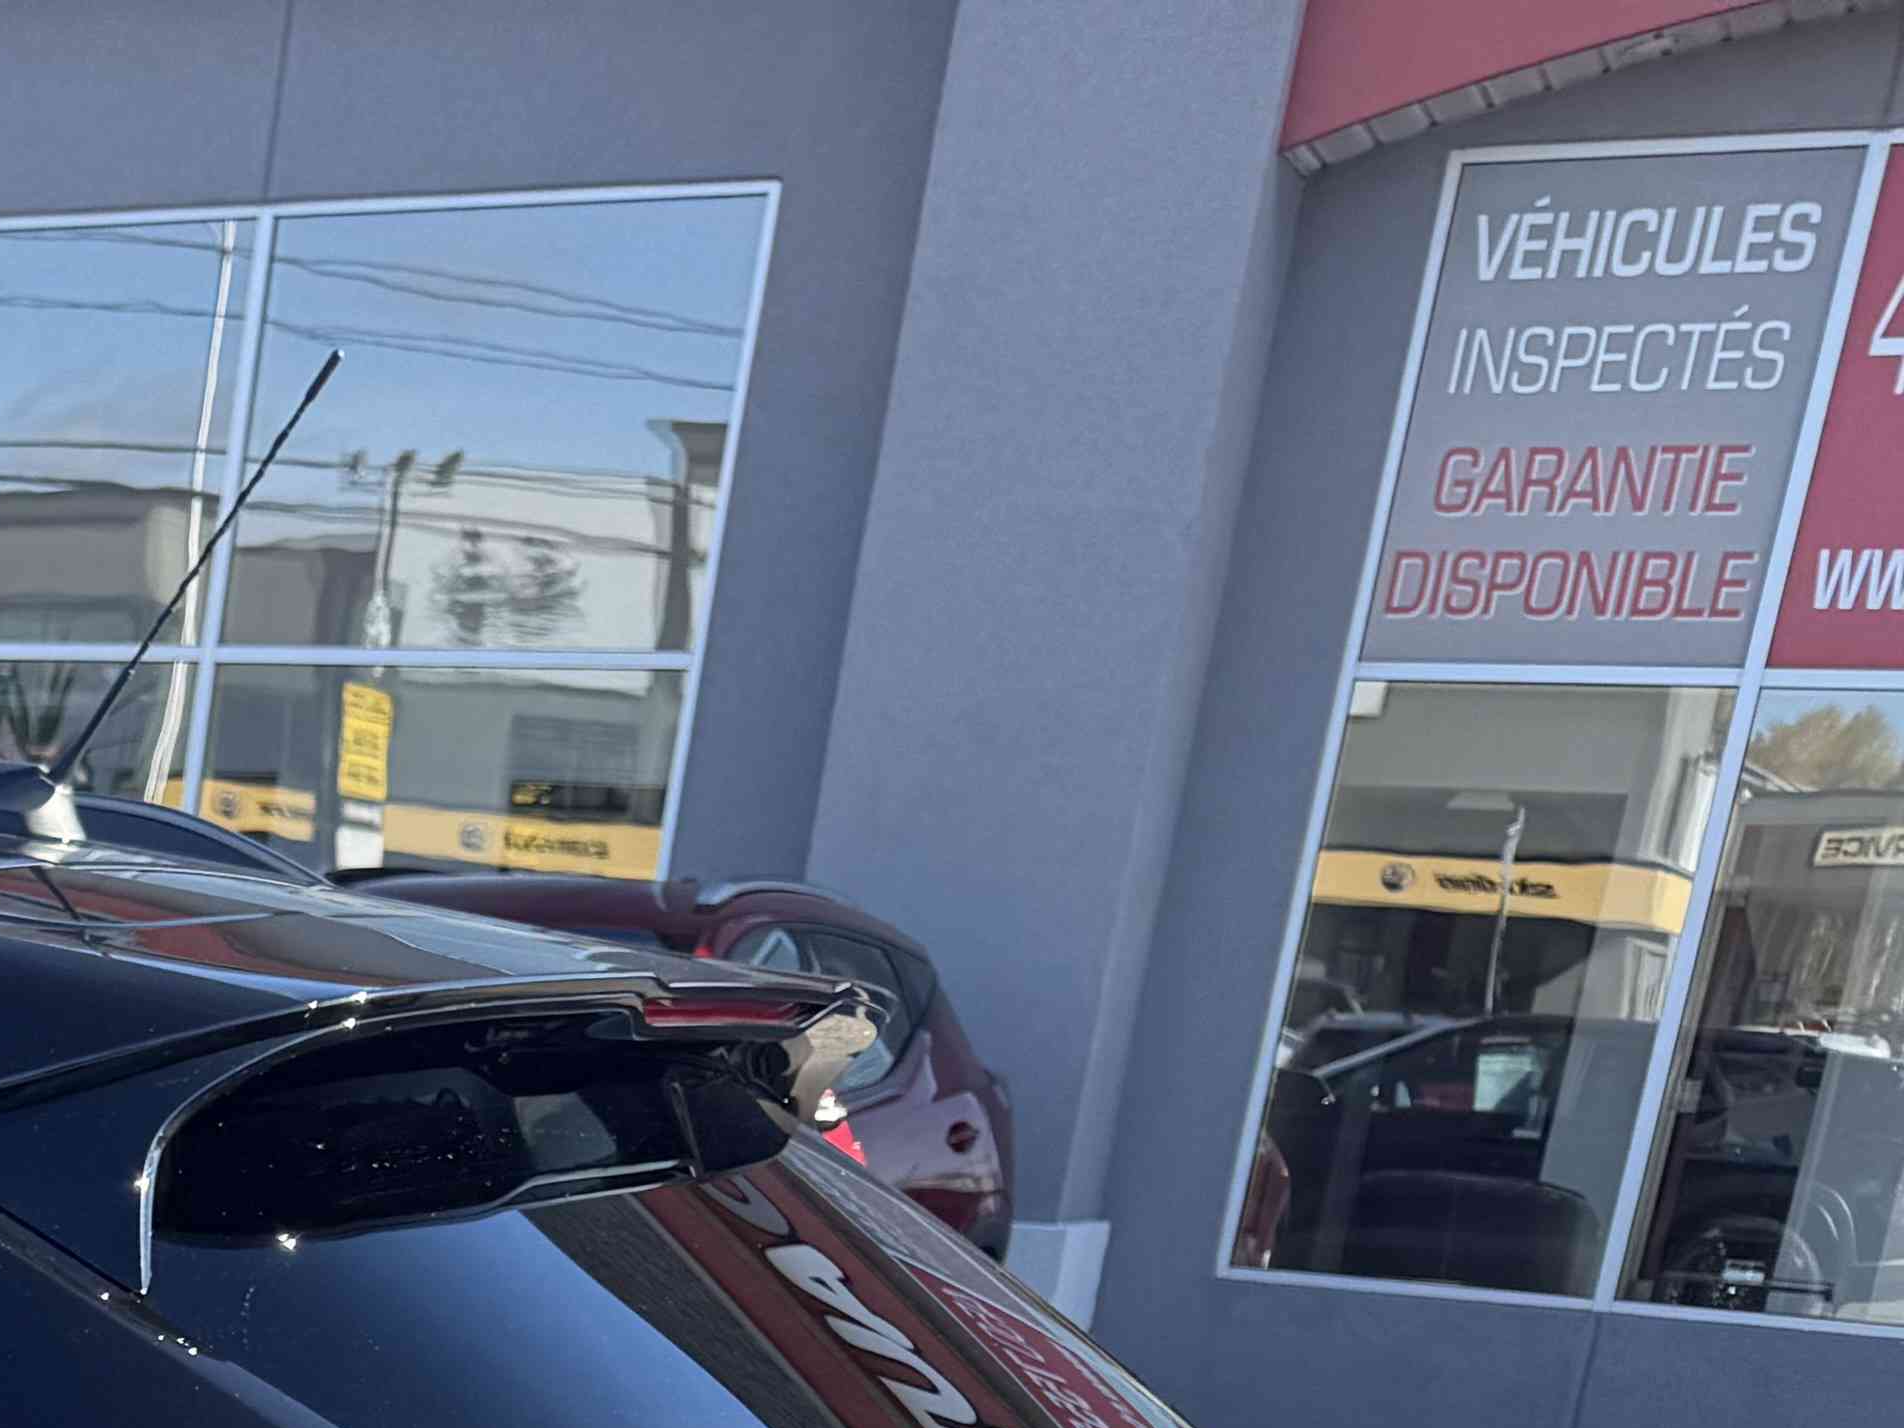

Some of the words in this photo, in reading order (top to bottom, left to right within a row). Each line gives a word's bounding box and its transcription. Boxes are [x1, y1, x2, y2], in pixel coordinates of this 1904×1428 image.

[1477, 196, 1822, 281] VÉHICULES
[1448, 304, 1792, 395] INSPECTÉS
[1432, 443, 1756, 517] GARANTIE
[1382, 549, 1758, 622] DISPONIBLE
